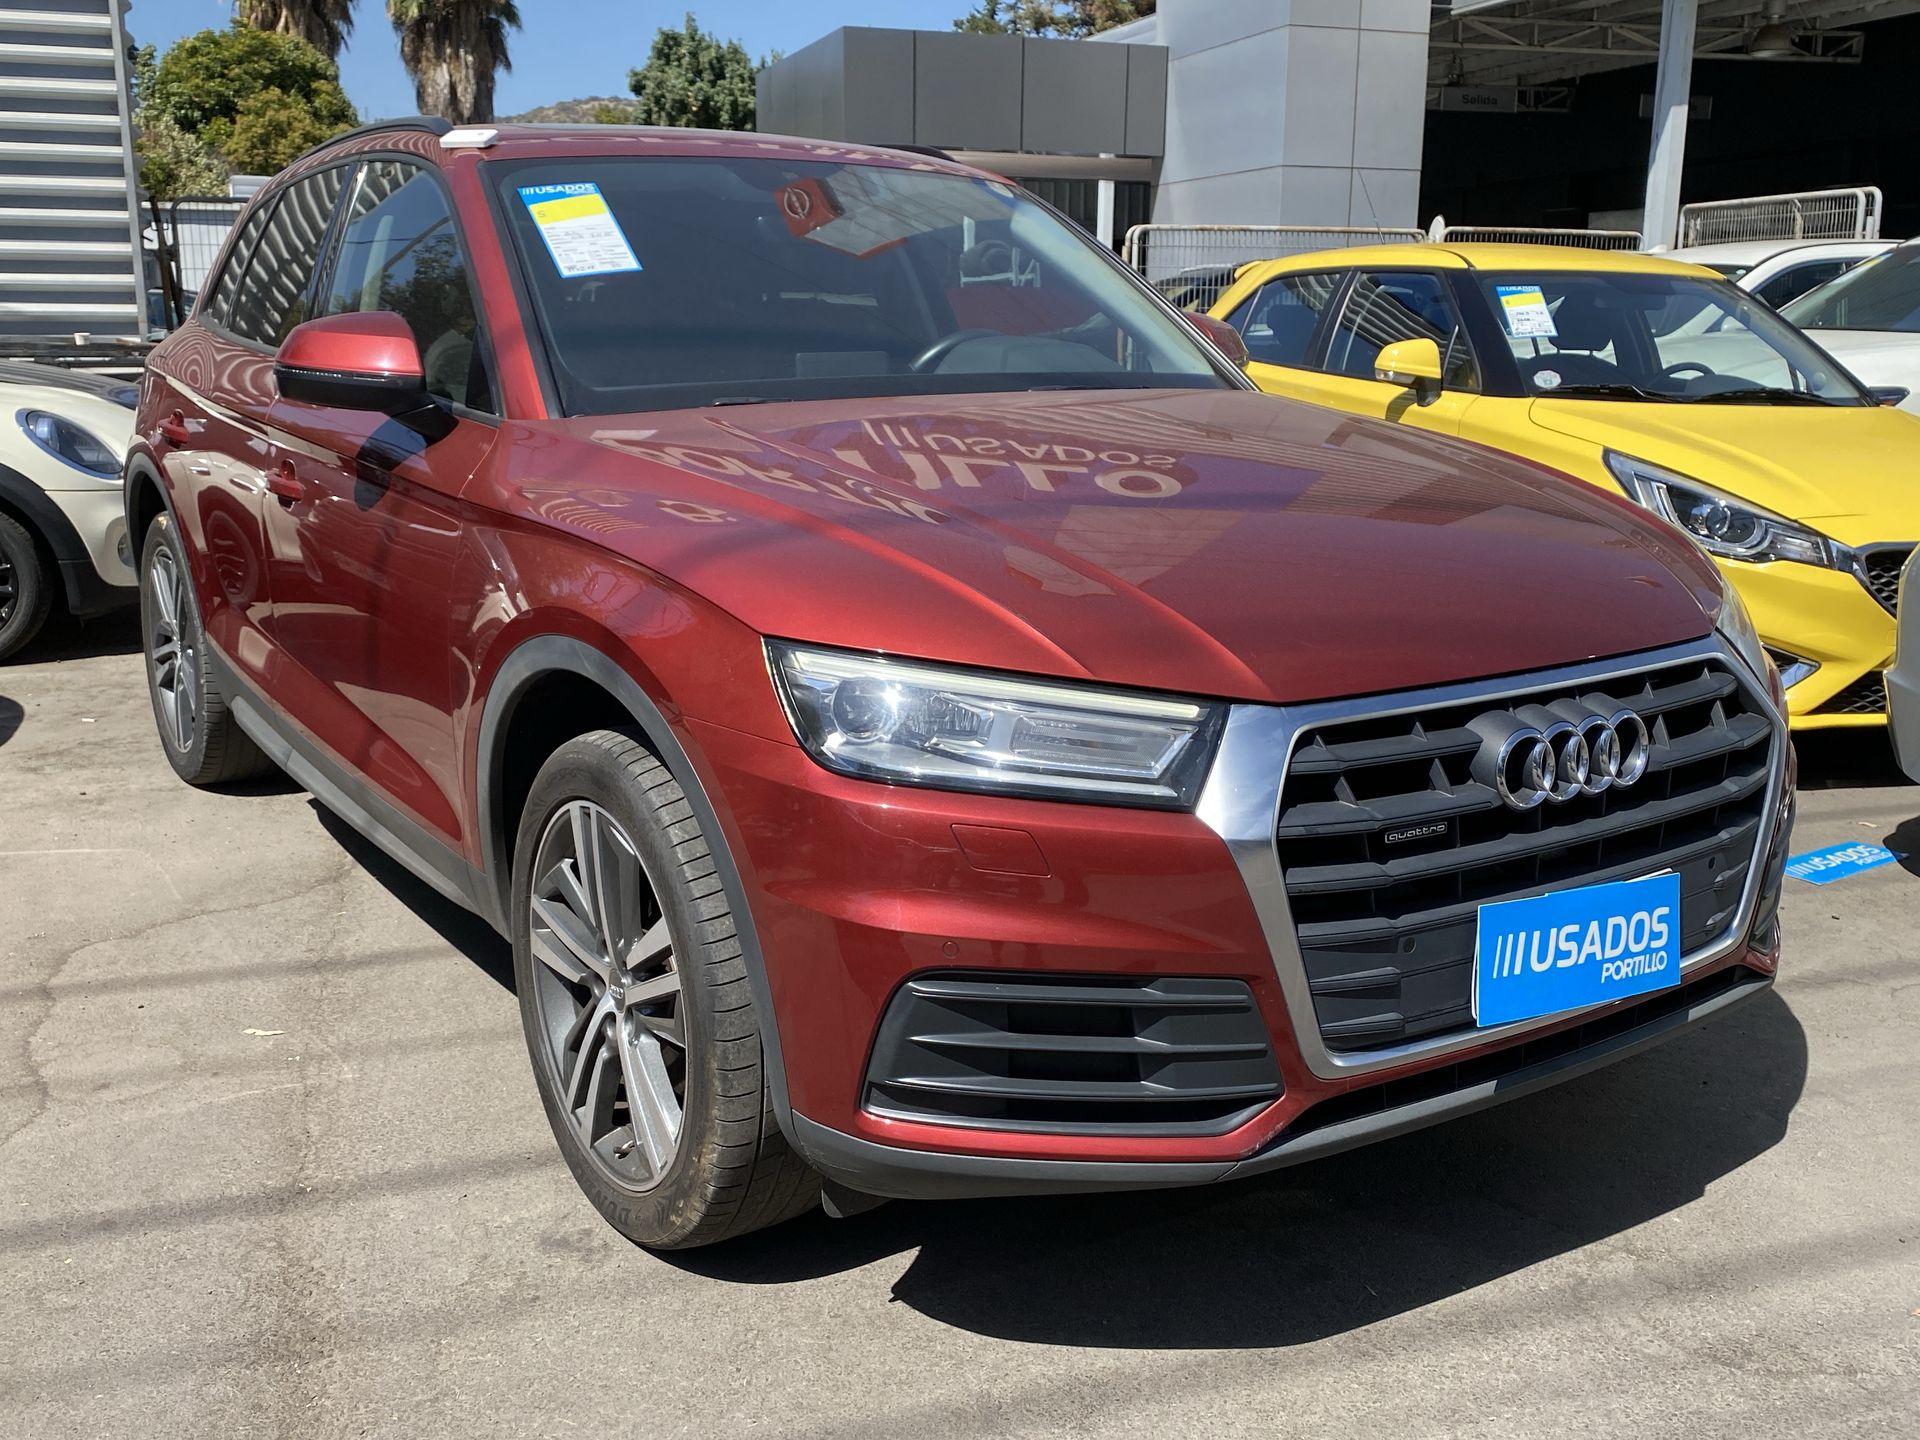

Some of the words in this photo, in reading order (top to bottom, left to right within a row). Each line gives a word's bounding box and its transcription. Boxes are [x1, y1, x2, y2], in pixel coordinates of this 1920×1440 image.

[1462, 94, 1498, 105] Salida
[535, 183, 594, 194] USADOS
[1388, 824, 1445, 841] quattro
[1806, 845, 1881, 871] USADOS
[1530, 906, 1670, 973] USADOS
[1601, 951, 1668, 984] PORTILLO
